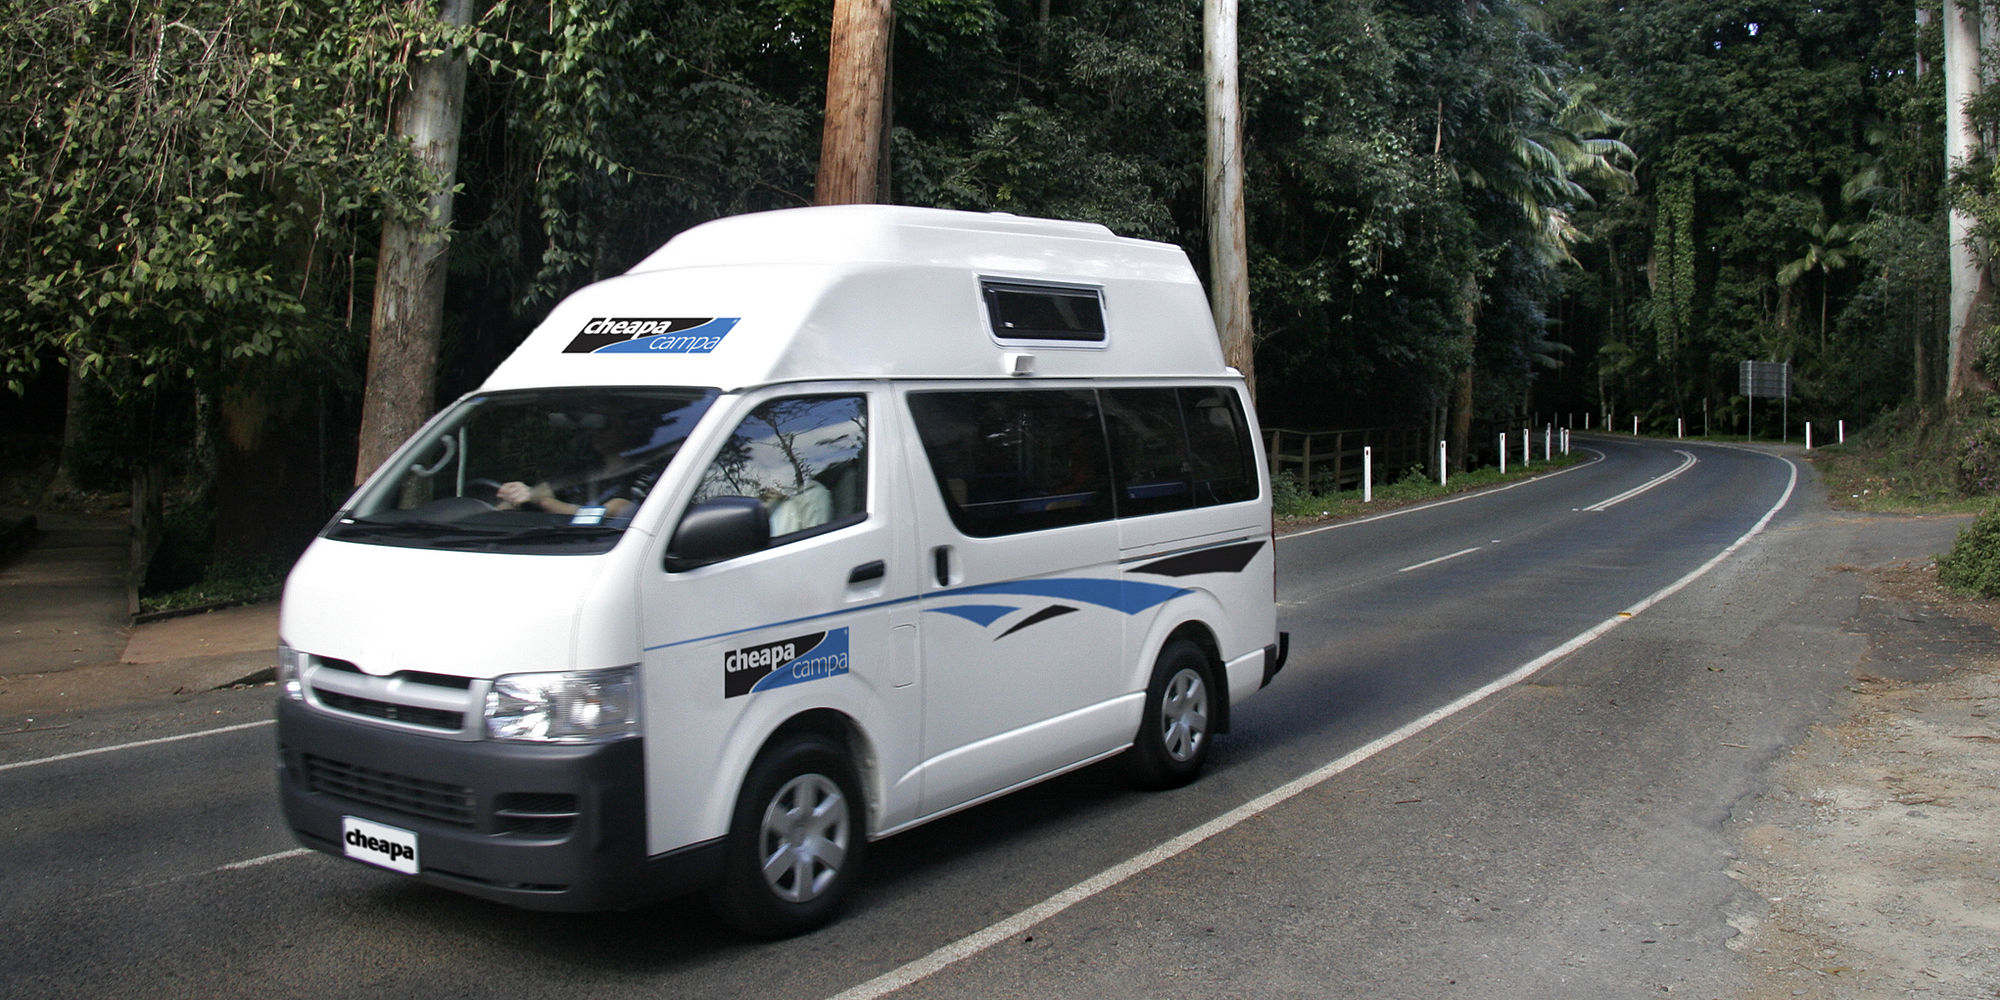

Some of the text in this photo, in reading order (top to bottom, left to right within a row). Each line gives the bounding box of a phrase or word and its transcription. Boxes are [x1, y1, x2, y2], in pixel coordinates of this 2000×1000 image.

[583, 317, 672, 340] cheapa
[649, 336, 721, 353] campa
[726, 642, 795, 672] cheapa
[792, 652, 848, 678] campa
[345, 828, 414, 862] cheapa
